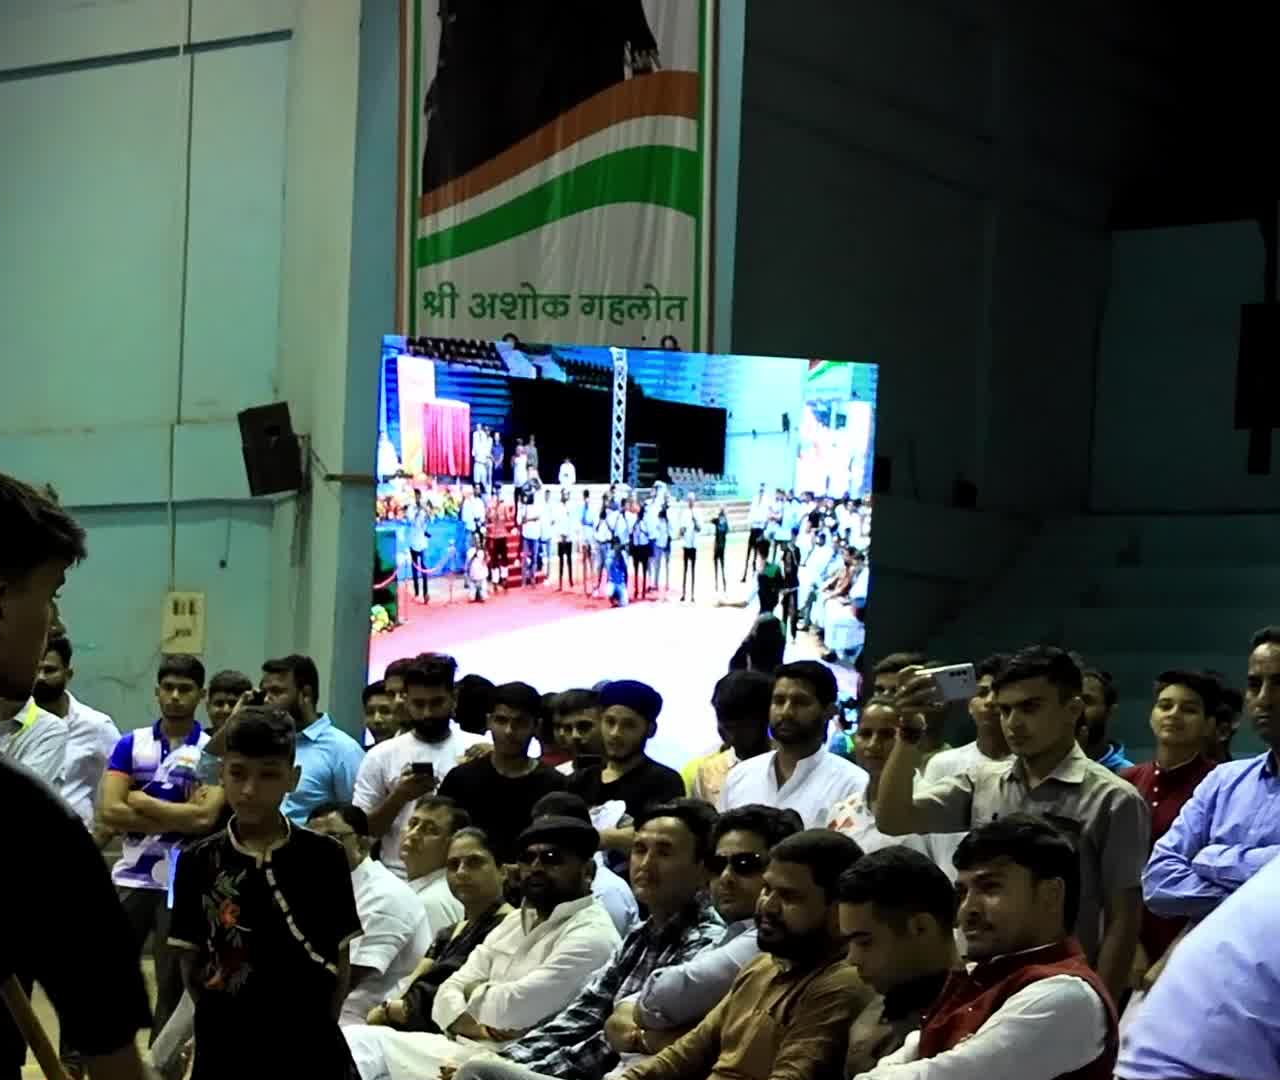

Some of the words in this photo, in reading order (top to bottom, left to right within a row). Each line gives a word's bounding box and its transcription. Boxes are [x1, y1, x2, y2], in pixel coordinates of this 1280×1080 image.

[423, 281, 459, 320] श्री
[468, 282, 571, 320] अशोक
[579, 283, 688, 325] गहलोत
